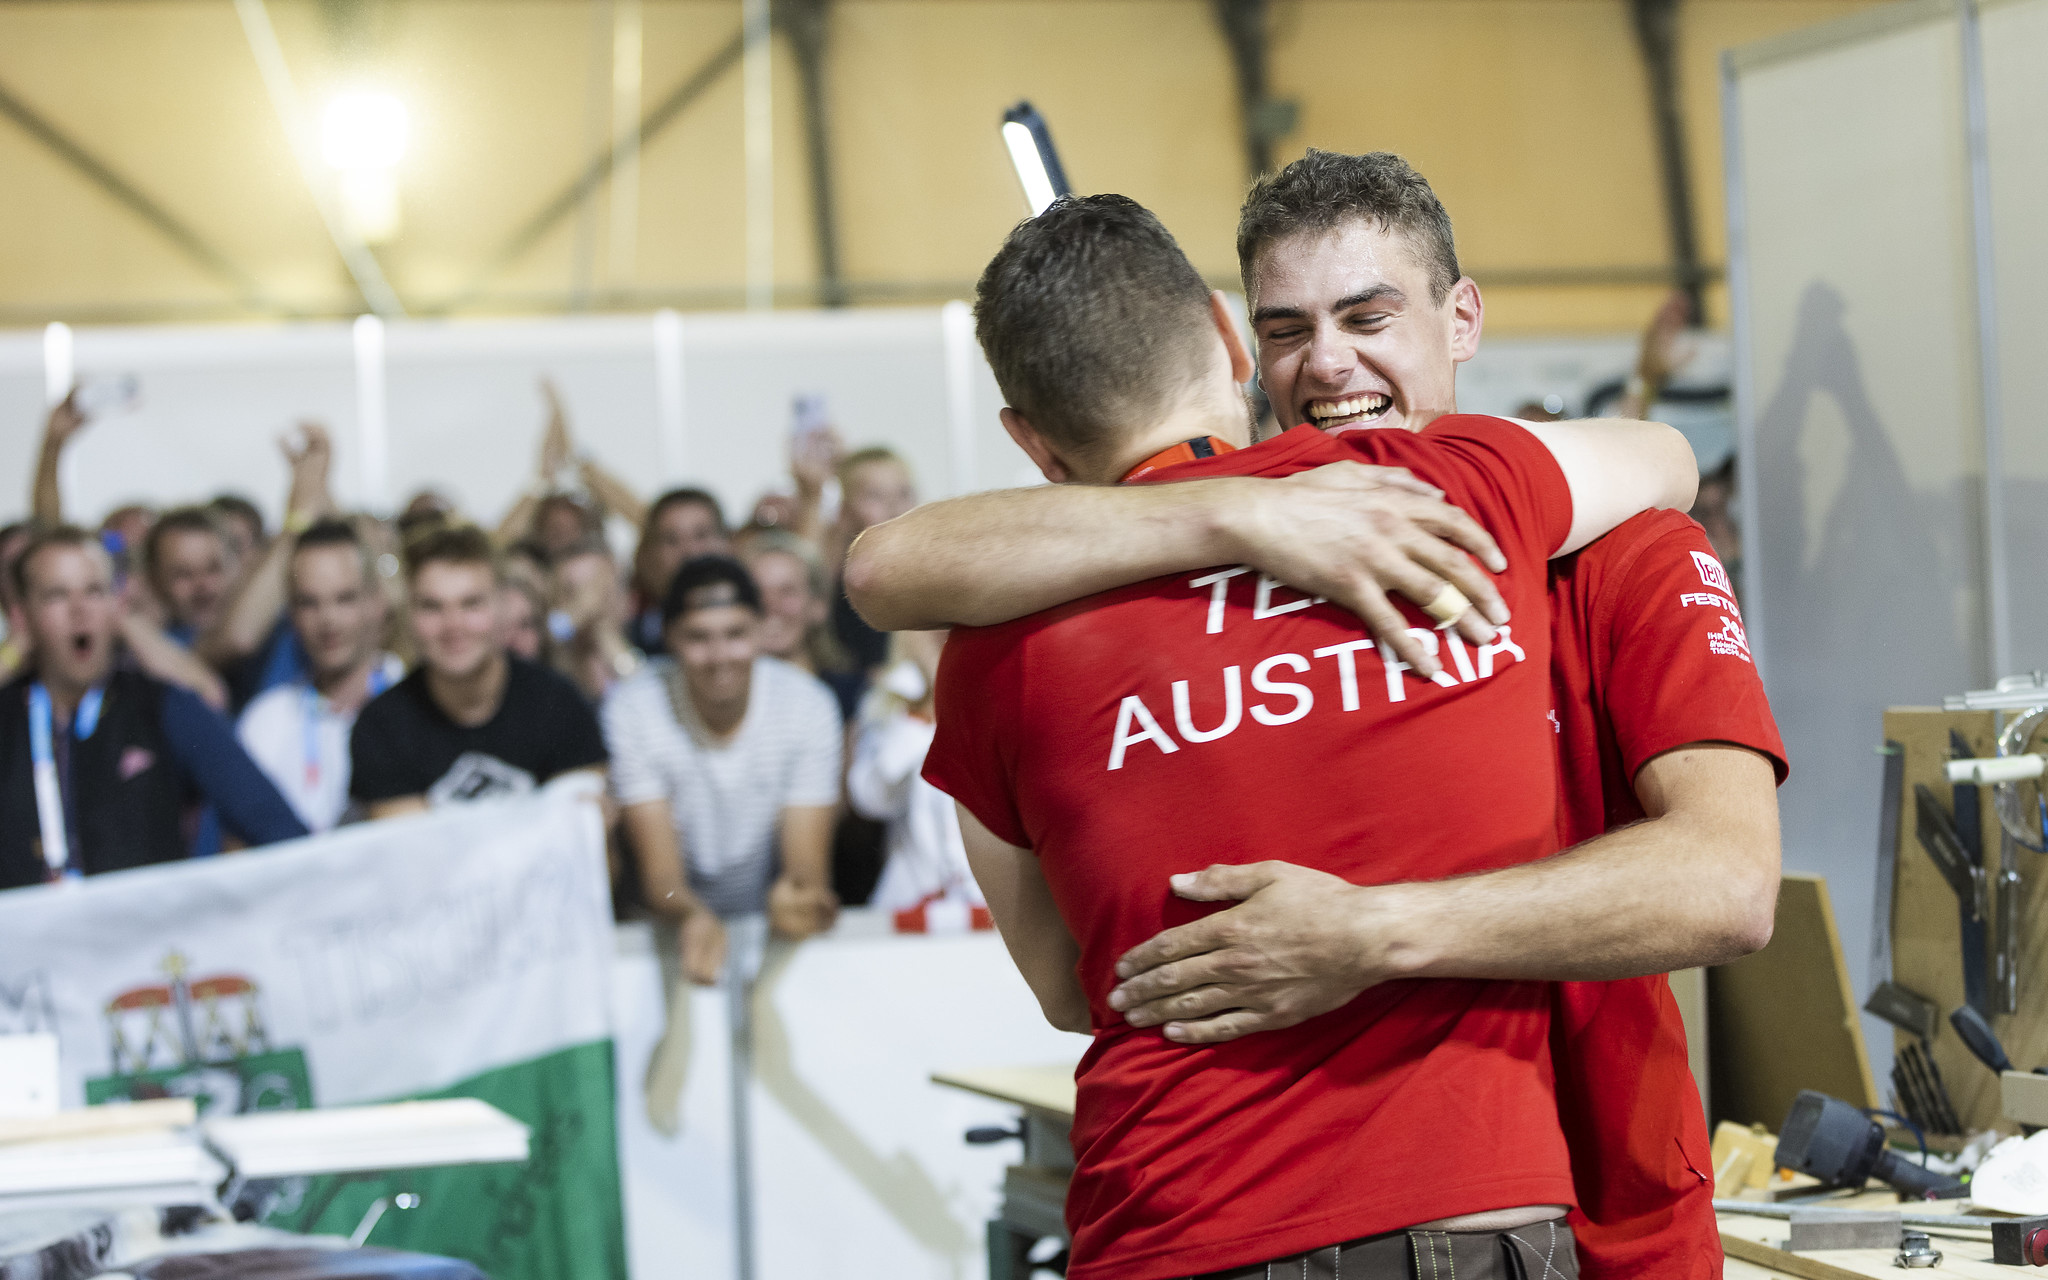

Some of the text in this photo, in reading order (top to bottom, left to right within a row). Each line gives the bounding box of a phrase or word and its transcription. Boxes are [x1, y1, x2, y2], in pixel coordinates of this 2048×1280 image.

[1189, 567, 1328, 634] TE
[1680, 592, 1742, 623] FESTO
[1107, 625, 1526, 771] AUSTRIA
